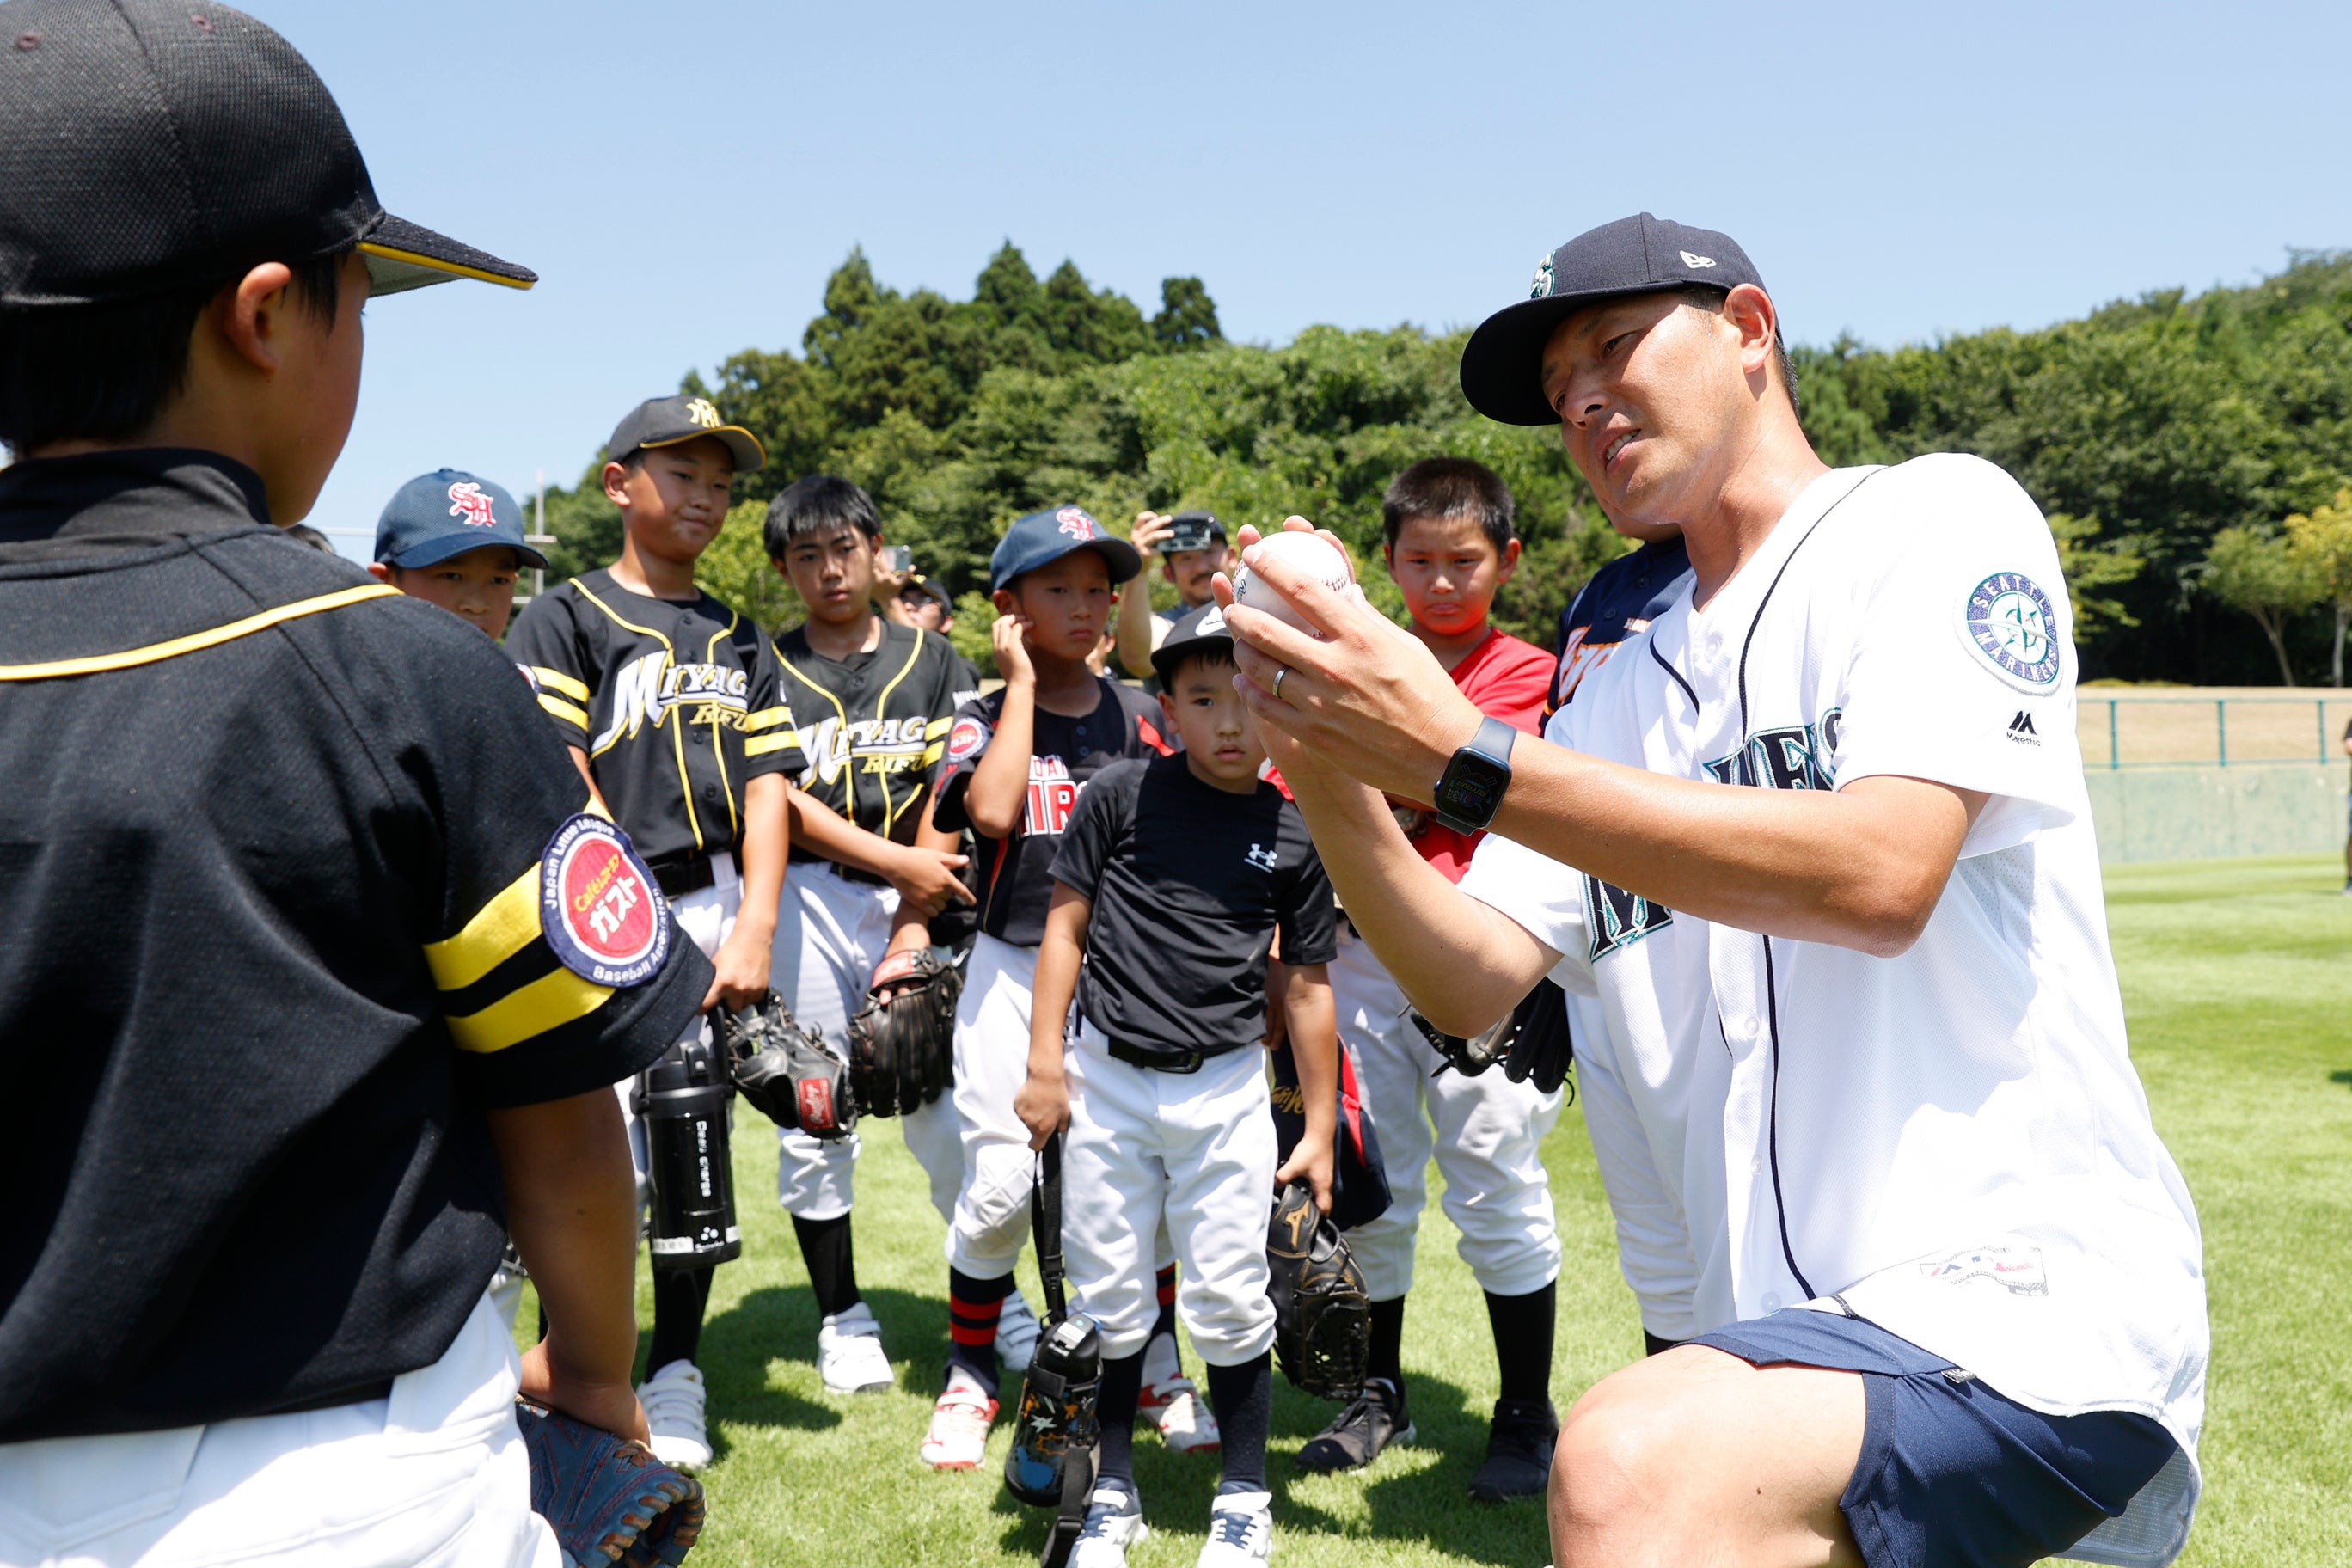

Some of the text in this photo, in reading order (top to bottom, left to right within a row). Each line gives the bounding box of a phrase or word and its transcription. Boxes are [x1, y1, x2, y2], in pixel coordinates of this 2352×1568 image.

[1972, 575, 2054, 626] SEATTLE
[1975, 631, 2056, 682] MARINERS
[591, 649, 749, 760] MIYAG
[797, 715, 928, 793] MIYAG
[2006, 731, 2041, 746] Majestic
[544, 818, 616, 910] Japan Little League
[589, 875, 638, 944] ガスト
[593, 961, 652, 983] Baseball
